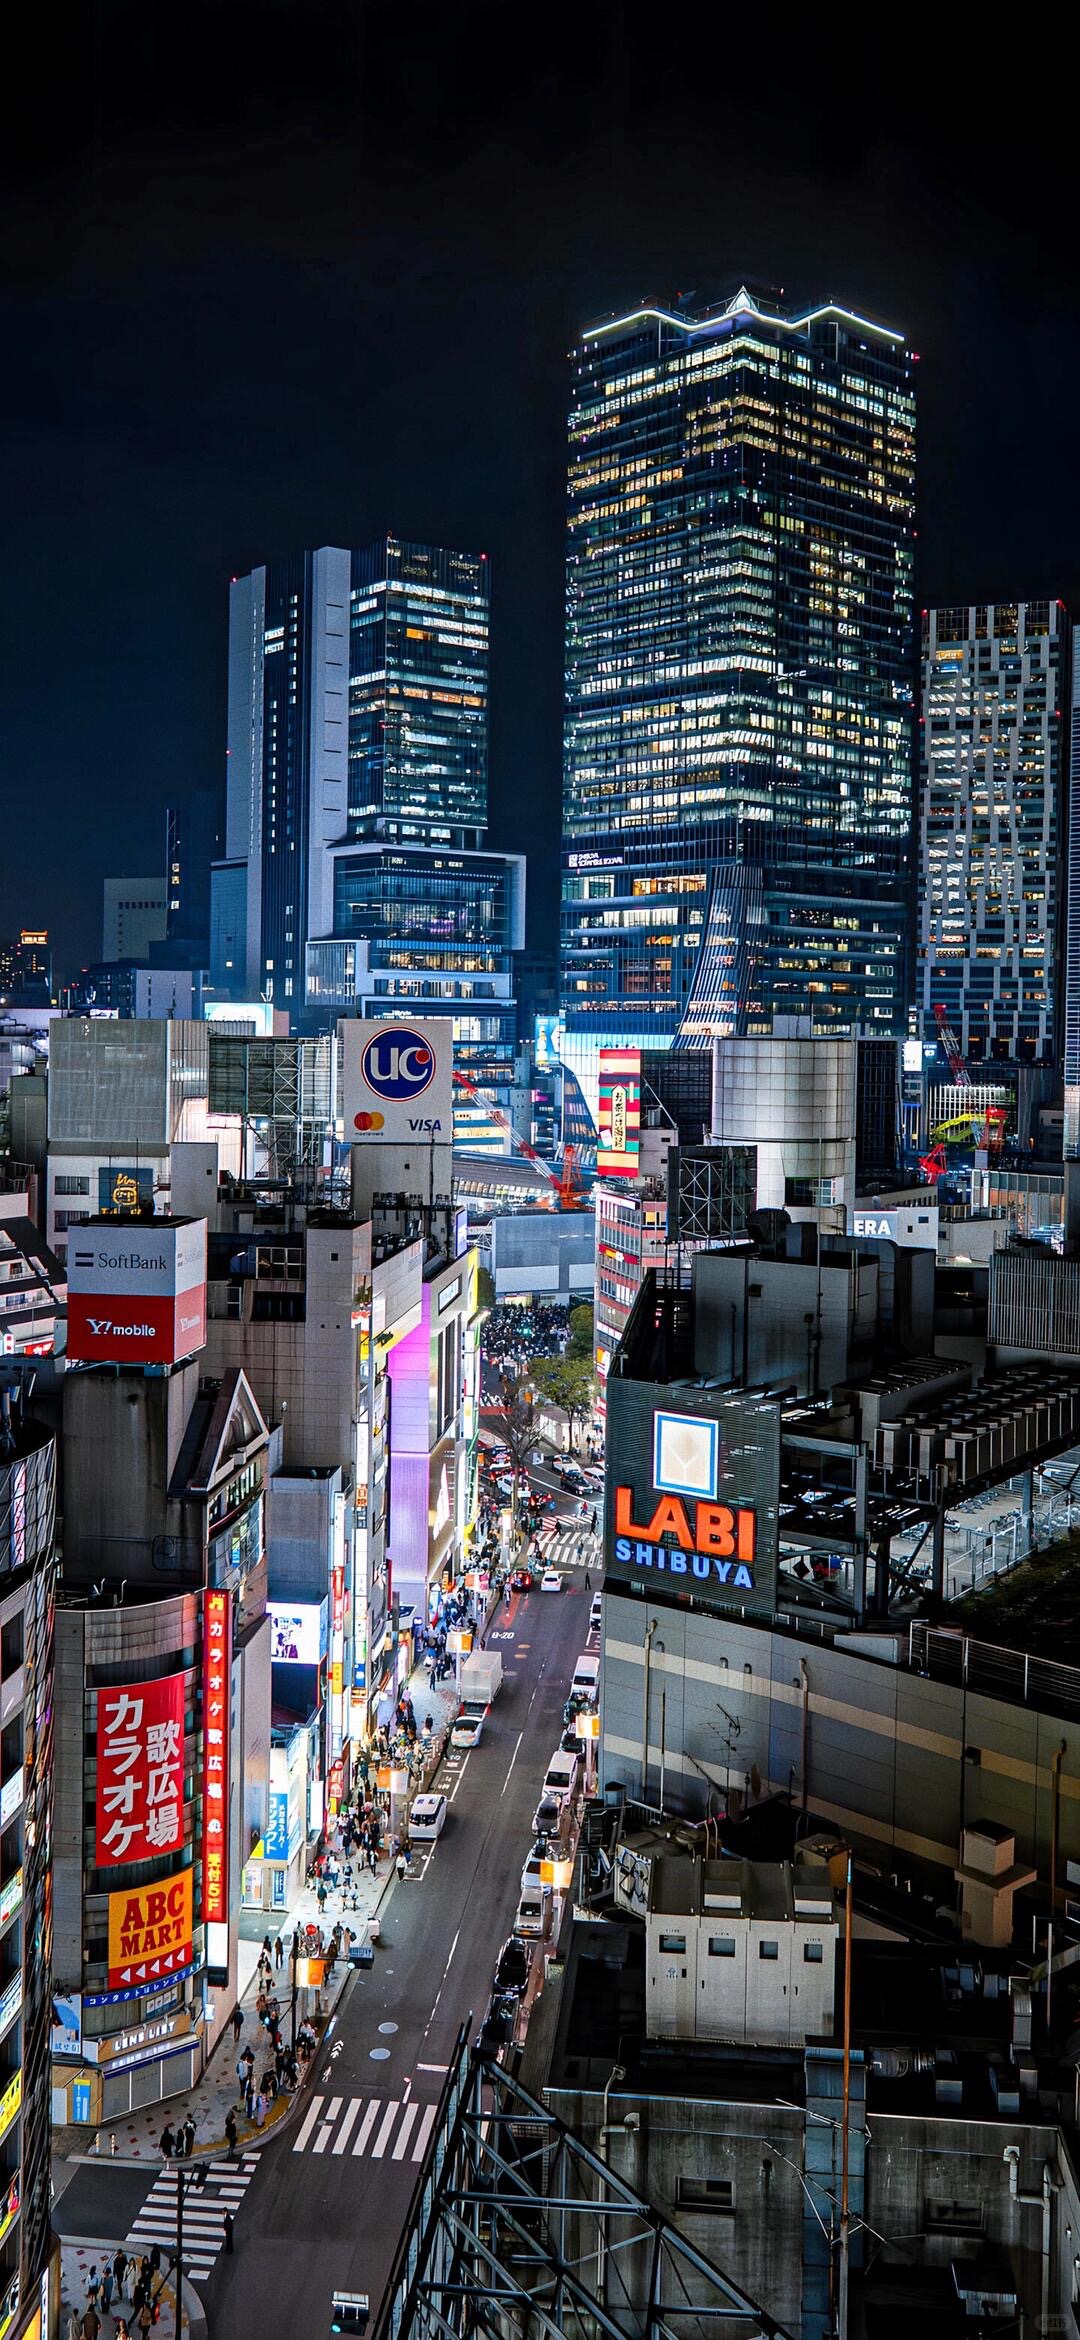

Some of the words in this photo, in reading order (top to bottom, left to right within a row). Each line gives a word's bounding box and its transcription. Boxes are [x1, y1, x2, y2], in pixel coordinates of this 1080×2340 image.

[407, 1119, 442, 1131] VISA
[853, 1220, 891, 1235] ERA
[98, 1253, 167, 1270] SoftBank
[615, 1486, 756, 1562] LABI
[616, 1539, 753, 1589] SHIBUYA
[102, 1694, 144, 1858] カラオケ
[145, 1720, 181, 1848] 歌広場
[120, 1882, 184, 1933] ABC
[120, 1917, 184, 1958] MART
